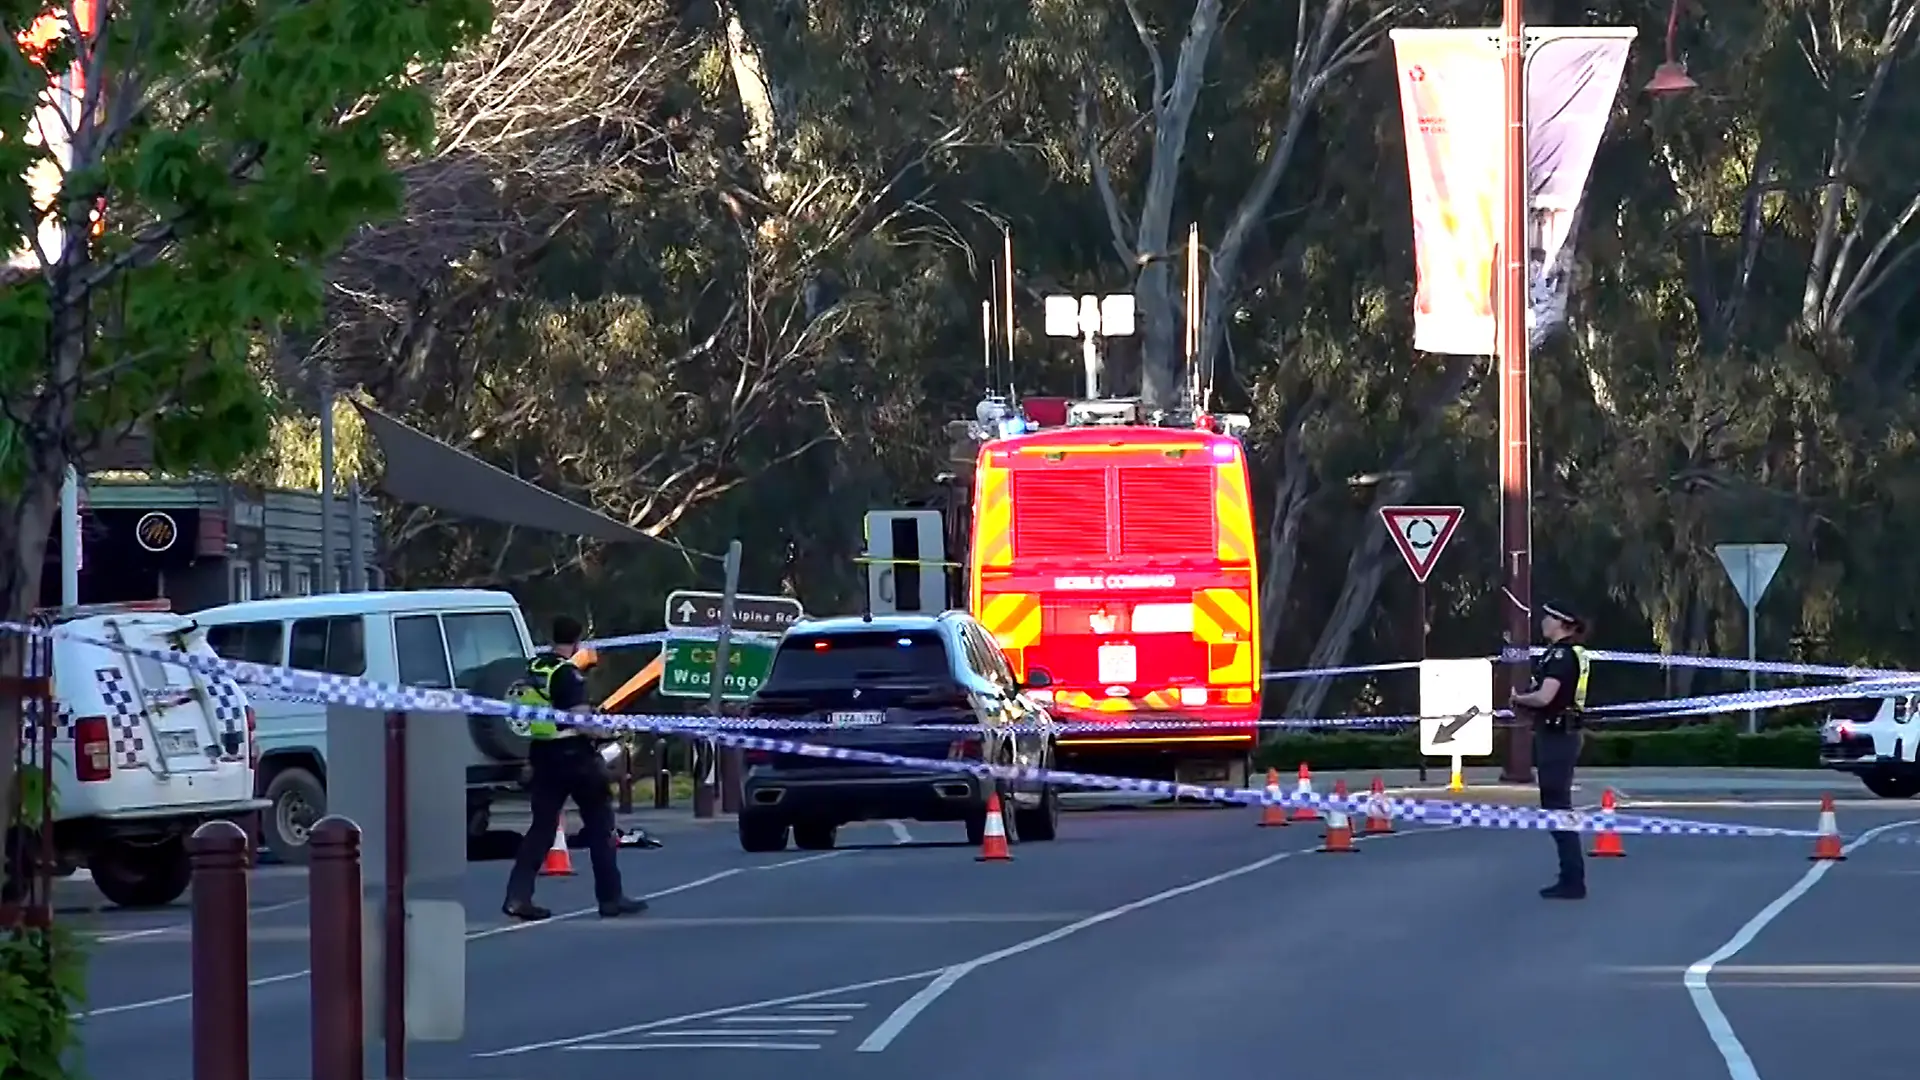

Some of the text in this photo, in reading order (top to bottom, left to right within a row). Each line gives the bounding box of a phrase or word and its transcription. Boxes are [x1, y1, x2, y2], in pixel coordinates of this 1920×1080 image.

[1054, 574, 1176, 590] MOBILE COMMAND
[690, 648, 742, 666] C34
[673, 669, 759, 691] Wodnga
